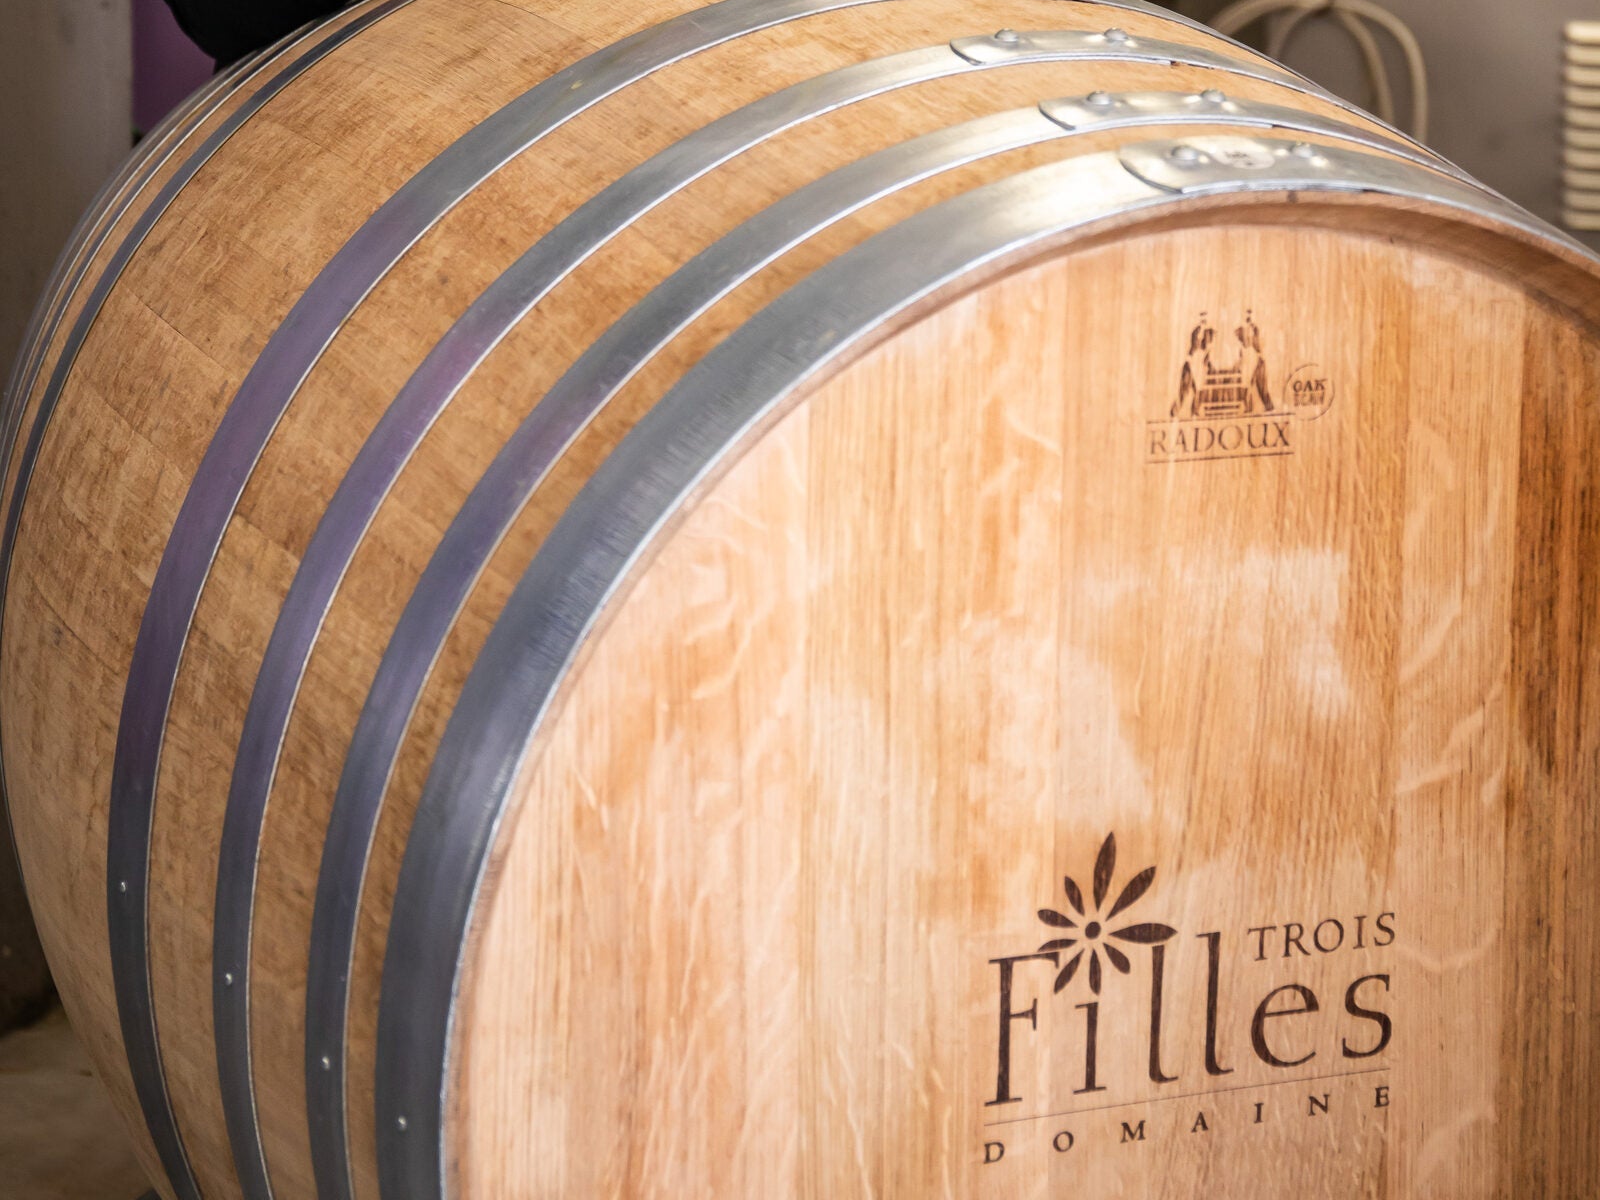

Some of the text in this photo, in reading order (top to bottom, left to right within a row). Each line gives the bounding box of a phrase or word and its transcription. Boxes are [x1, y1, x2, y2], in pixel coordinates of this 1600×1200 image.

[1293, 378, 1327, 392] OAK
[1149, 420, 1291, 455] RADOUX
[1247, 911, 1396, 962] TROIS
[984, 930, 1393, 1107] Filles
[983, 1085, 1391, 1164] DOMAINE
